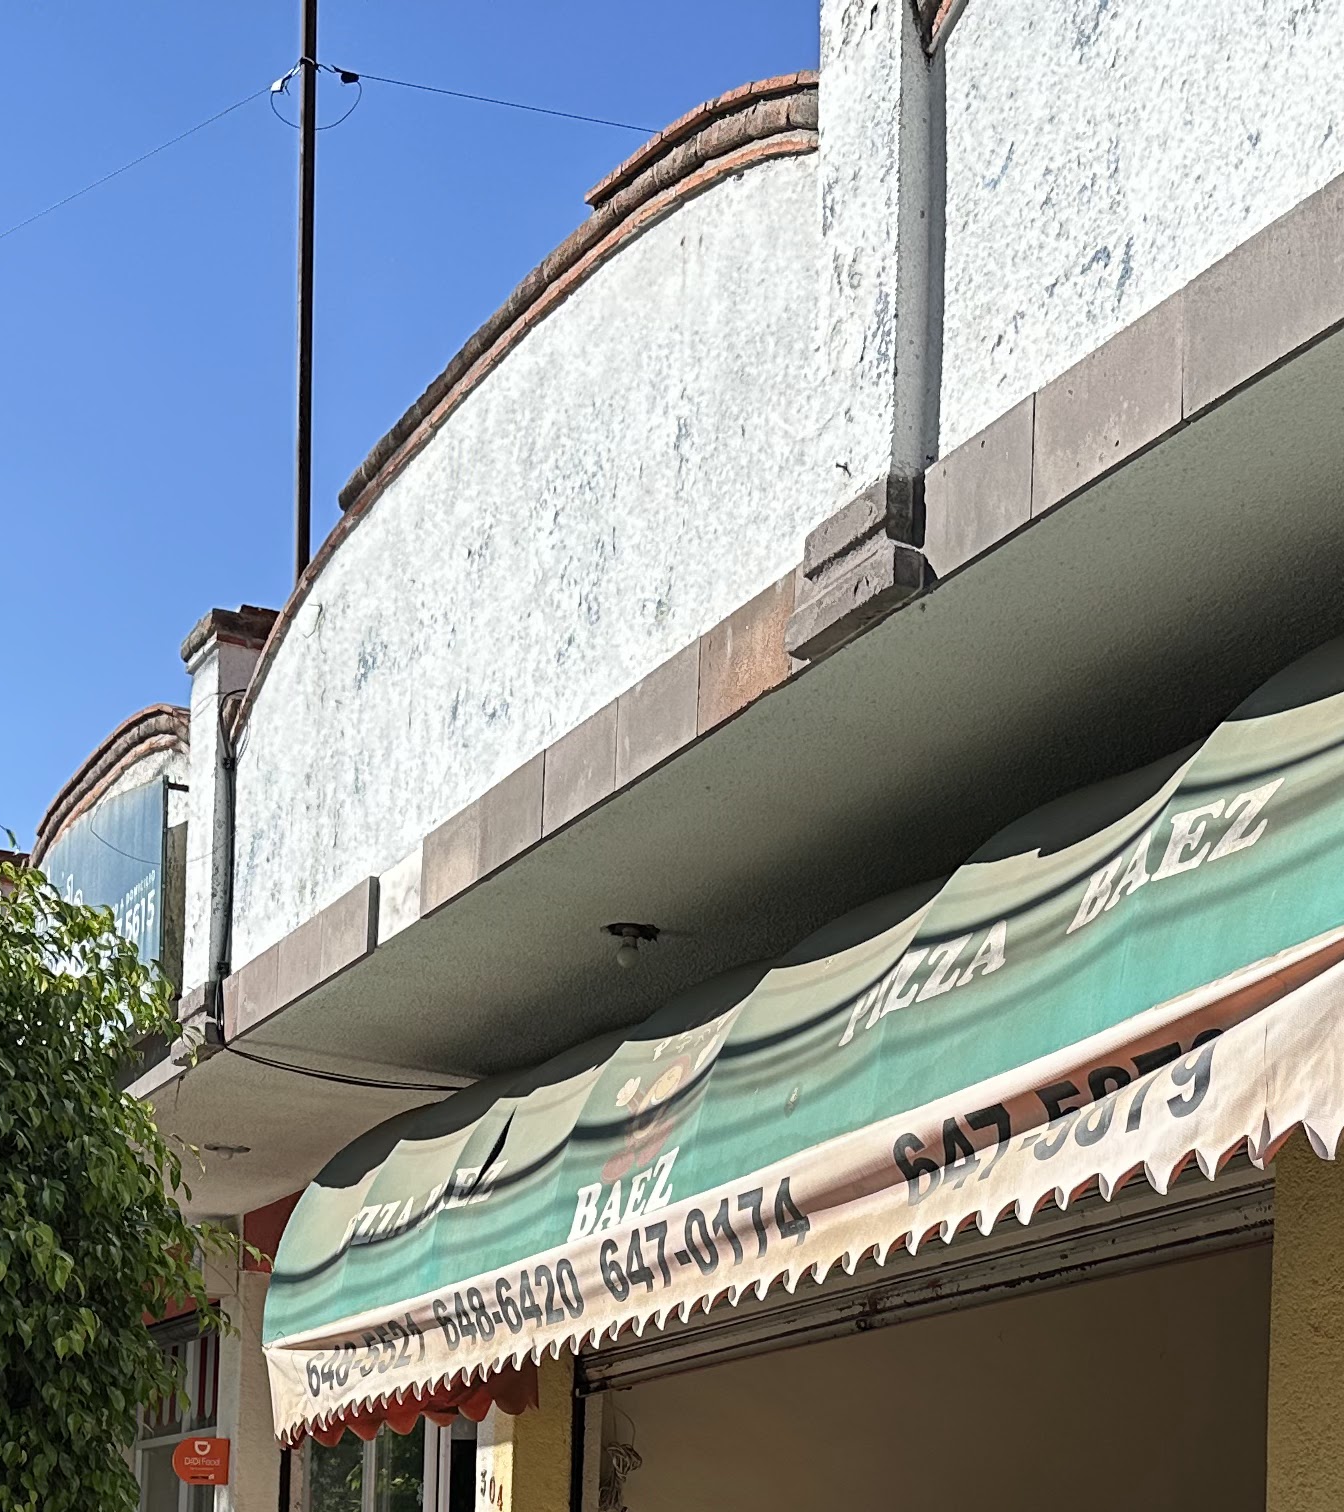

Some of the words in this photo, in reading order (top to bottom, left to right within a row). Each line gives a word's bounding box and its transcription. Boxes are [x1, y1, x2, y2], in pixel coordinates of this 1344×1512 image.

[838, 920, 1008, 1047] PIZZA
[1065, 777, 1285, 935] BAEZ
[335, 1196, 414, 1256] PZZA
[566, 1145, 680, 1243] BAEZ
[305, 1312, 426, 1398] 648-5521
[432, 1258, 585, 1351] 648-6420
[599, 1176, 811, 1302] 647-0174
[480, 1468, 504, 1512] 304
